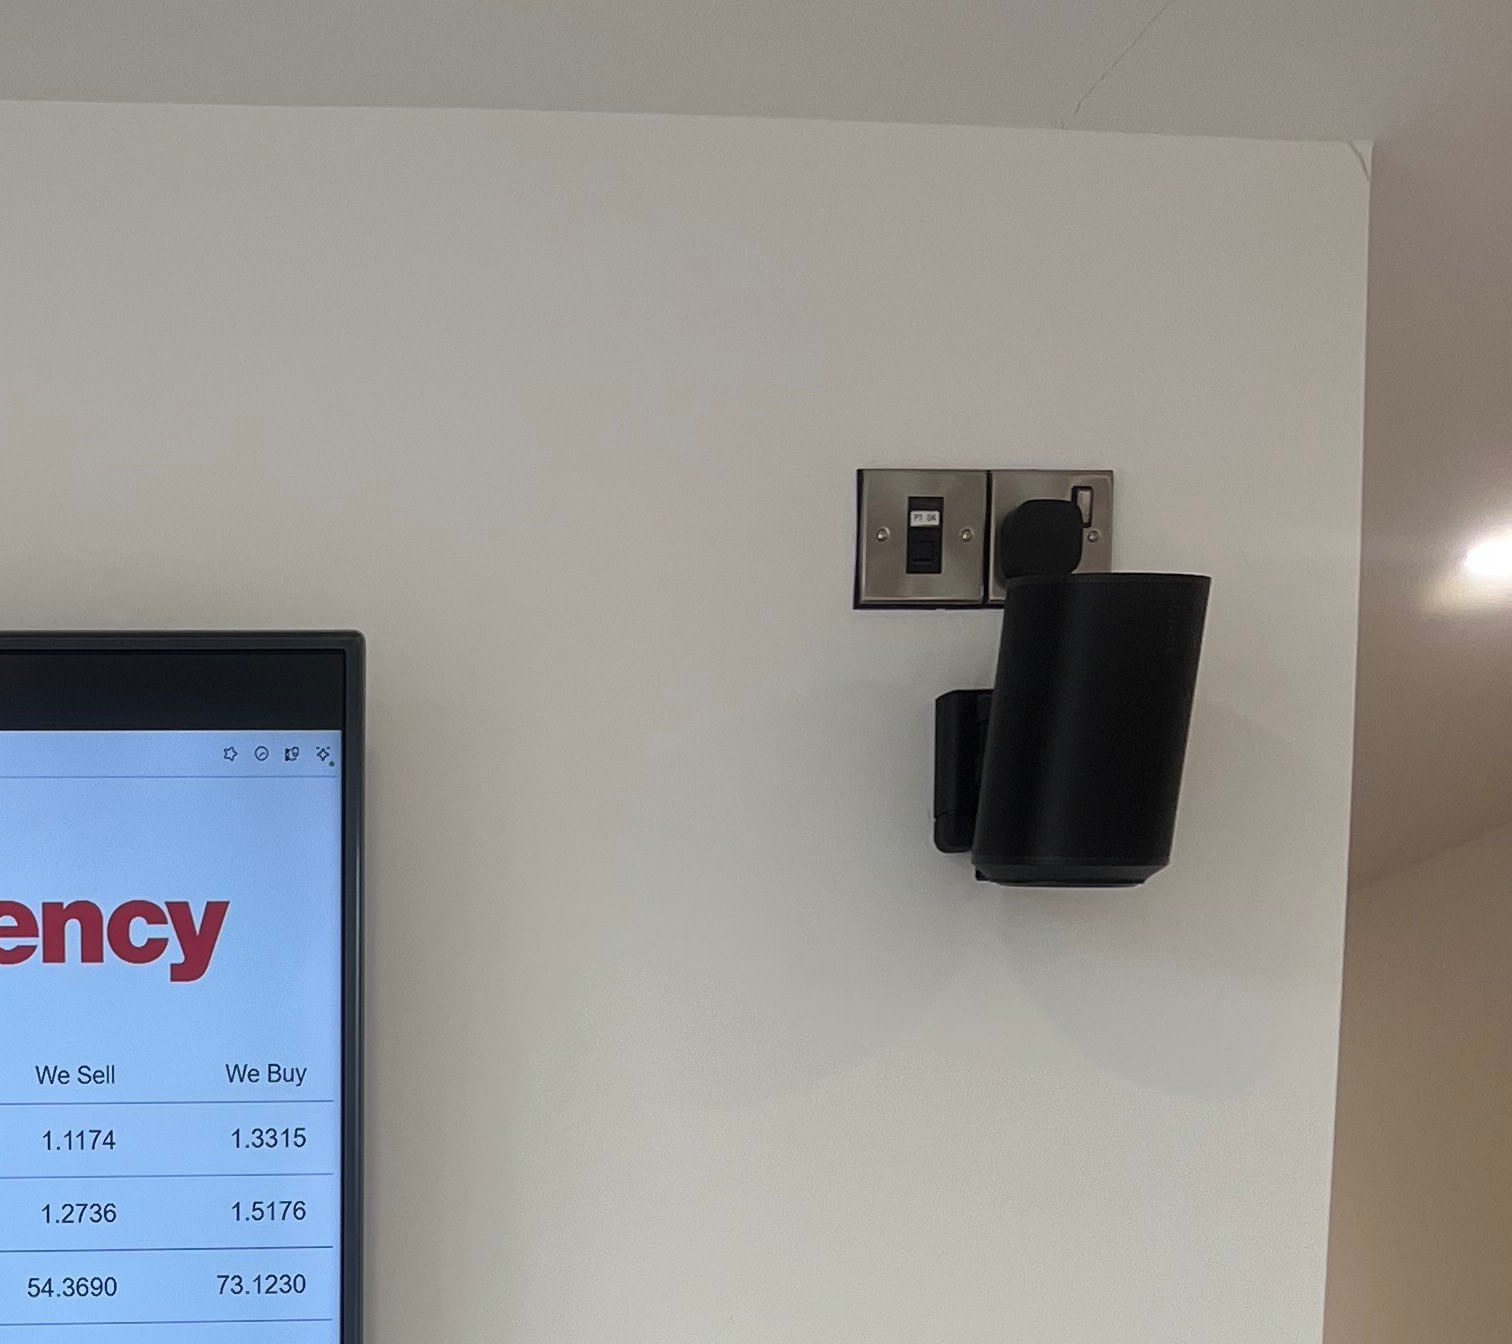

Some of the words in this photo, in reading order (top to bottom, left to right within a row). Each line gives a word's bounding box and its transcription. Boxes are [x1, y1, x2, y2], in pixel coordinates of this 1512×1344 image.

[35, 1065, 70, 1084] We
[78, 1065, 114, 1084] Sell
[226, 1064, 259, 1083] We
[268, 1064, 307, 1087] Buy
[43, 1130, 115, 1150] 1.1174
[232, 1128, 306, 1148] 1.3315
[42, 1203, 116, 1223] 1.2736
[232, 1201, 306, 1221] 1.5176
[28, 1277, 117, 1297] 54.3690
[217, 1274, 305, 1294] 73.1230
